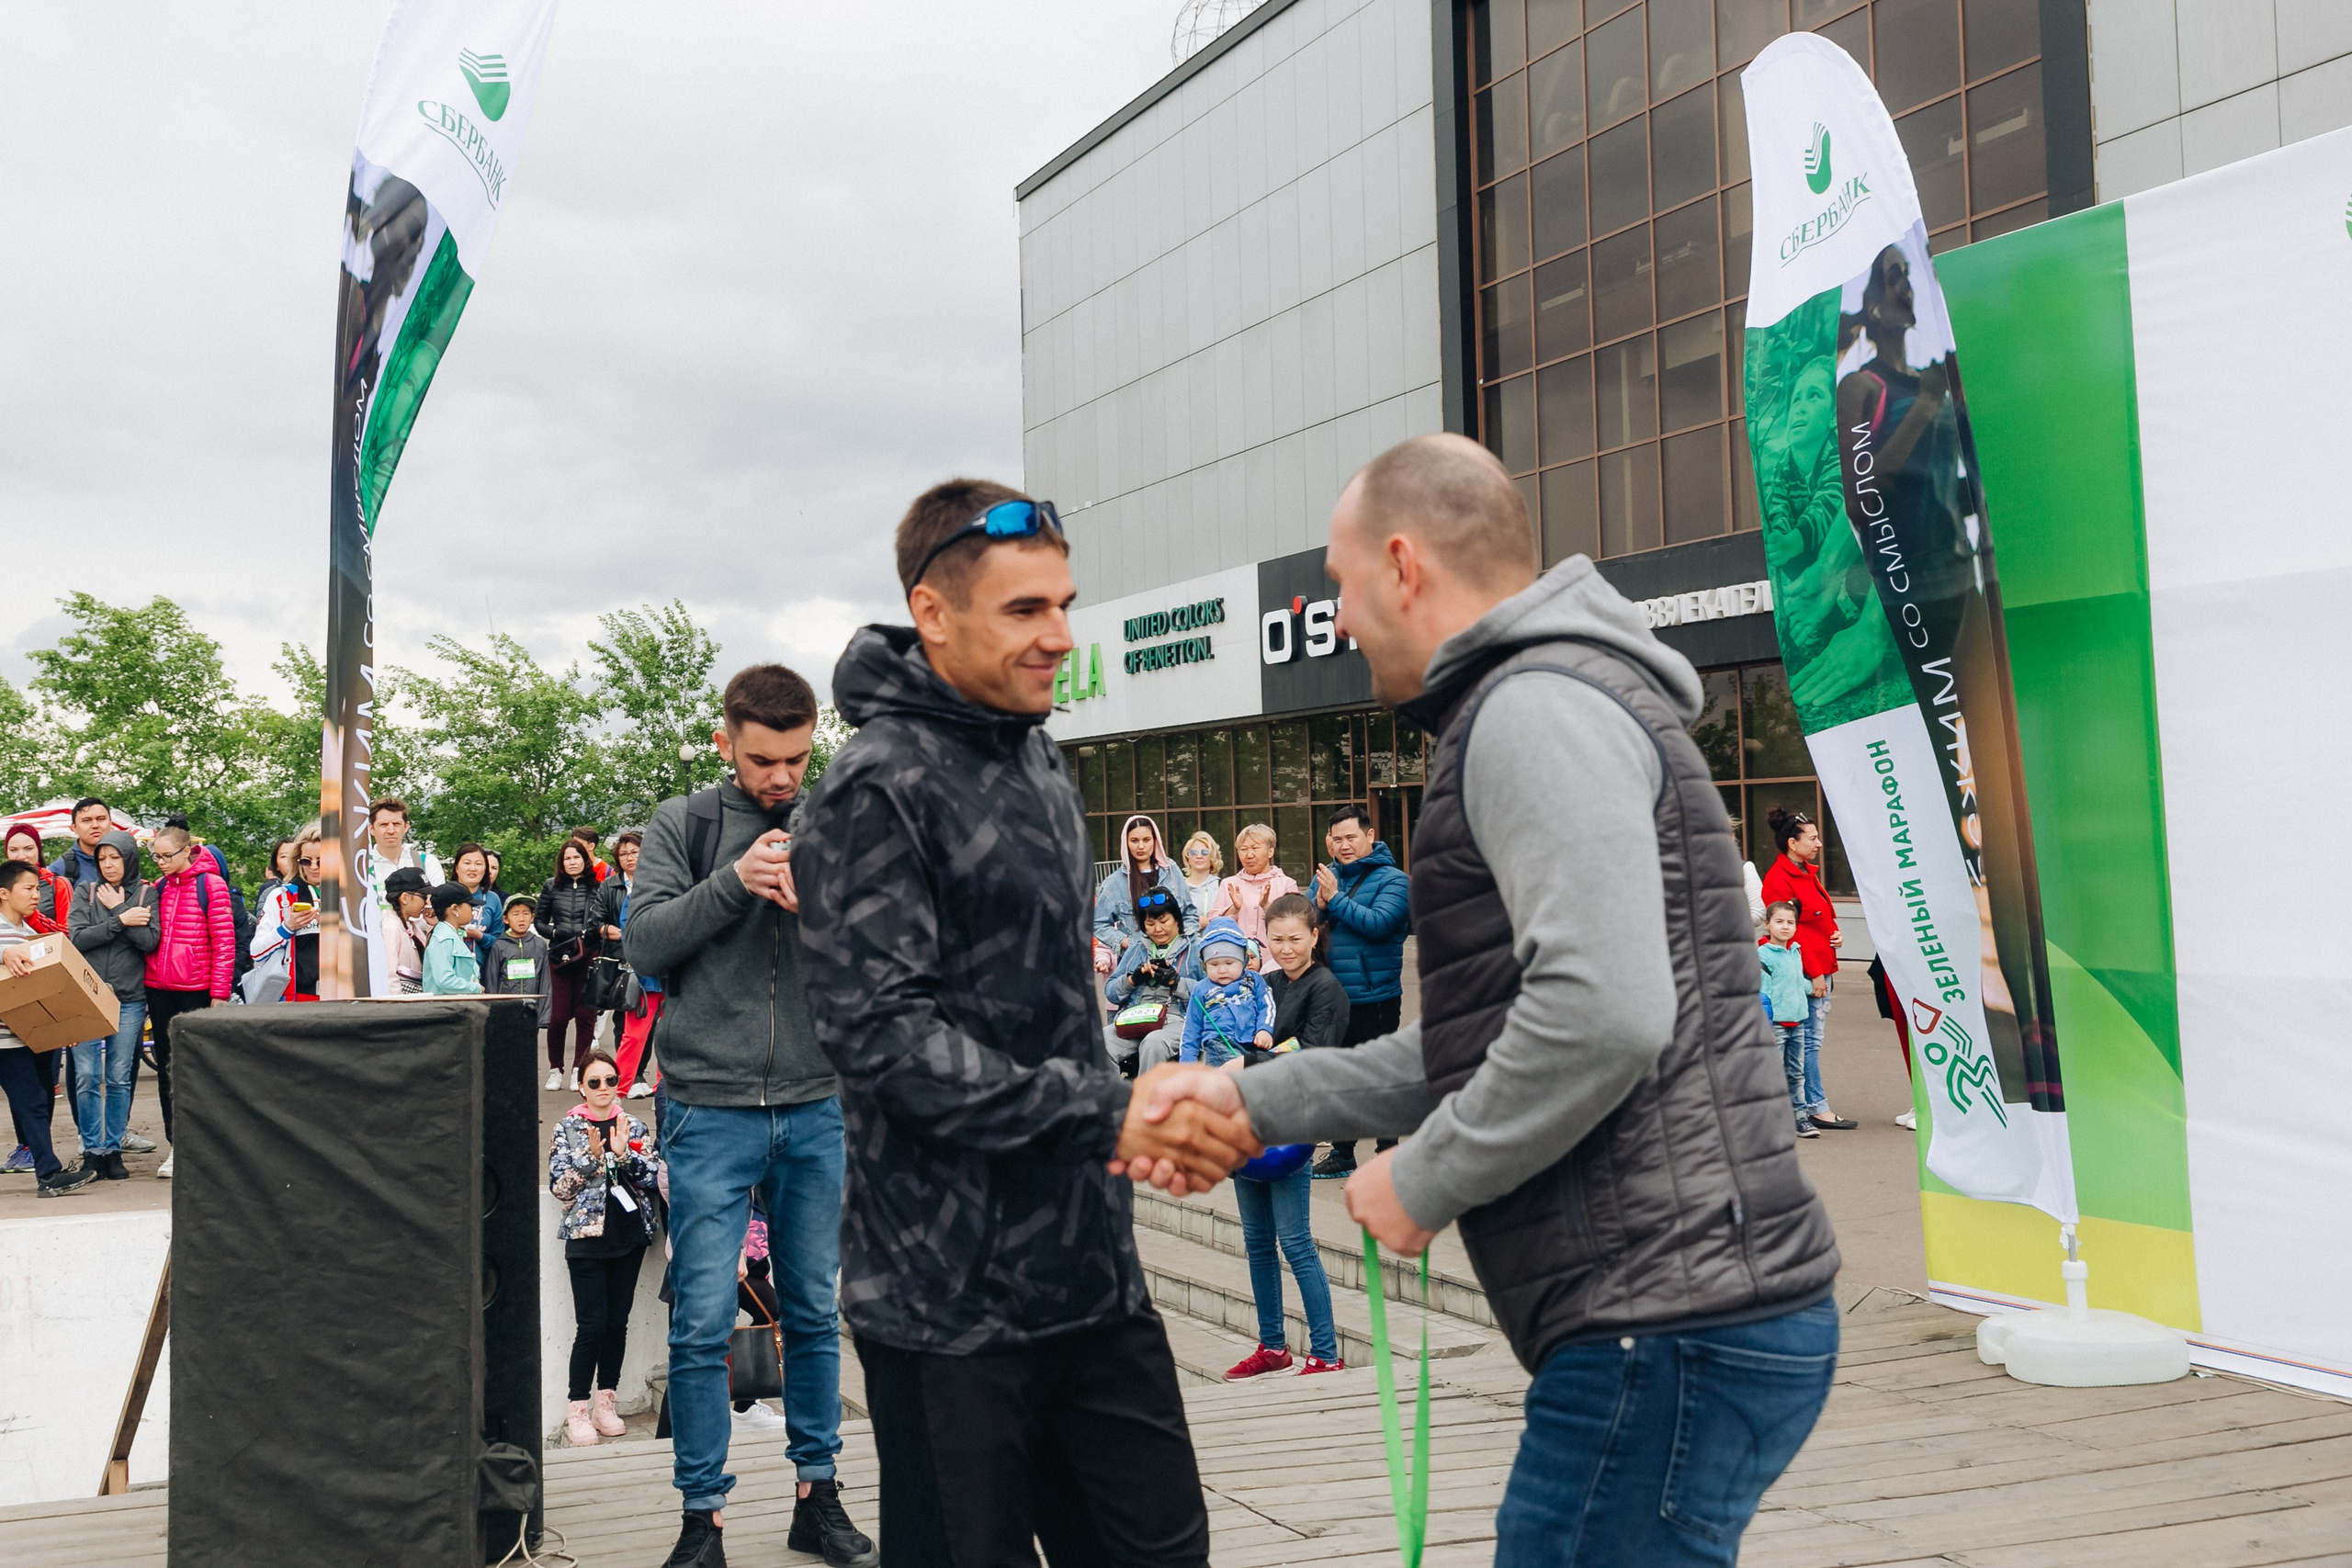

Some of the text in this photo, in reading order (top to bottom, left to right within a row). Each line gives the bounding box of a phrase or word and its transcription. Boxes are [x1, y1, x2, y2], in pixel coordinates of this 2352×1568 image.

[417, 100, 507, 203] СБЕРБАНК
[1780, 171, 1871, 261] СБЕРБАНК
[1123, 597, 1225, 642] UNITED COLORS
[1124, 649, 1142, 674] OF
[1866, 739, 1965, 1003] ЗЕЛЕНЫЙ МАРАФОН
